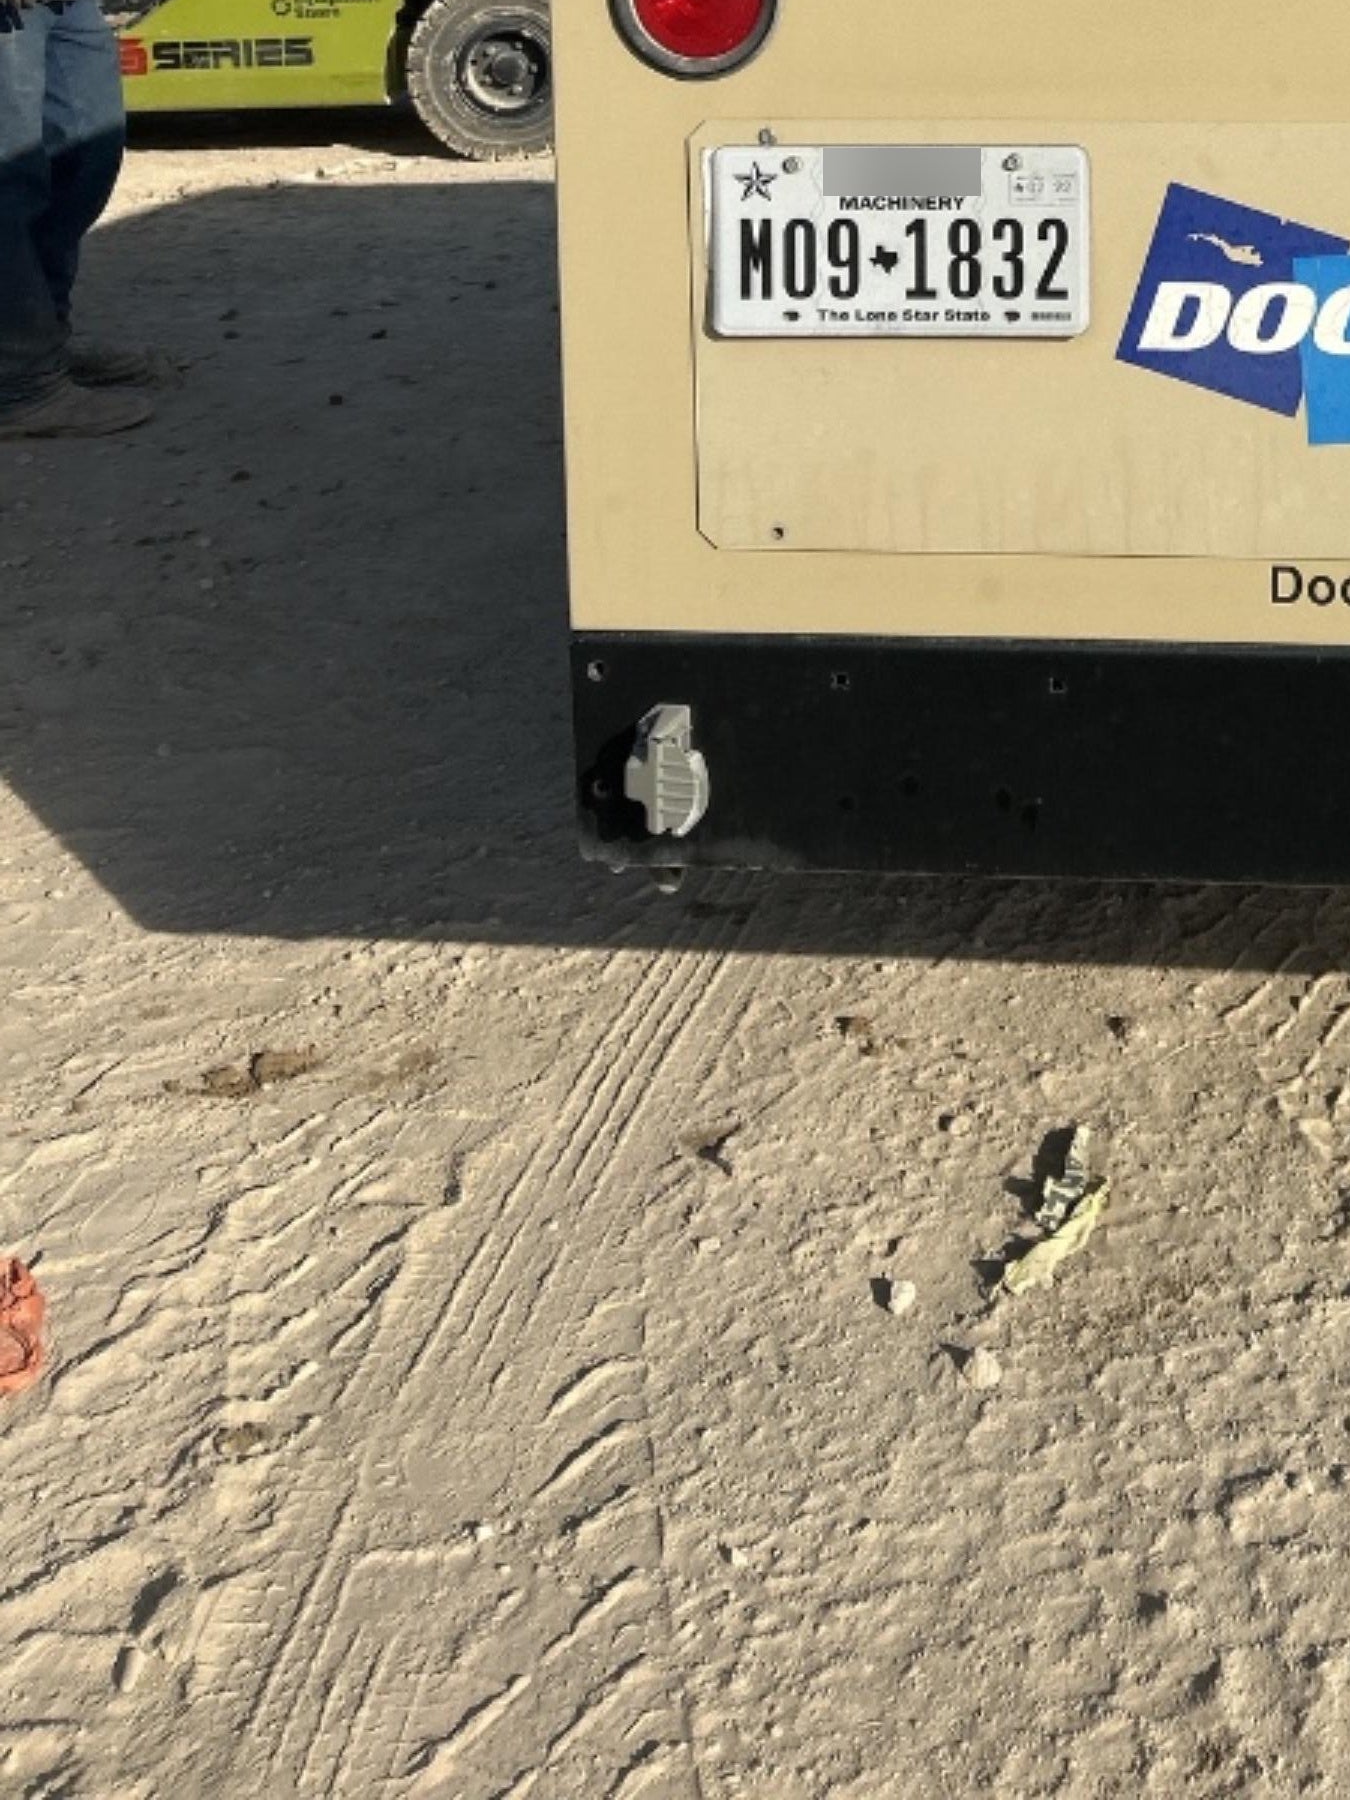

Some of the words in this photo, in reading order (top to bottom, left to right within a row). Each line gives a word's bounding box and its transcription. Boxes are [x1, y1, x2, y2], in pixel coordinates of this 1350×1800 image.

[152, 35, 314, 70] SERIES
[839, 196, 965, 211] MACHINERY
[816, 309, 850, 321] The
[855, 309, 897, 322] Lone
[903, 309, 939, 322] Star
[945, 309, 991, 322] State
